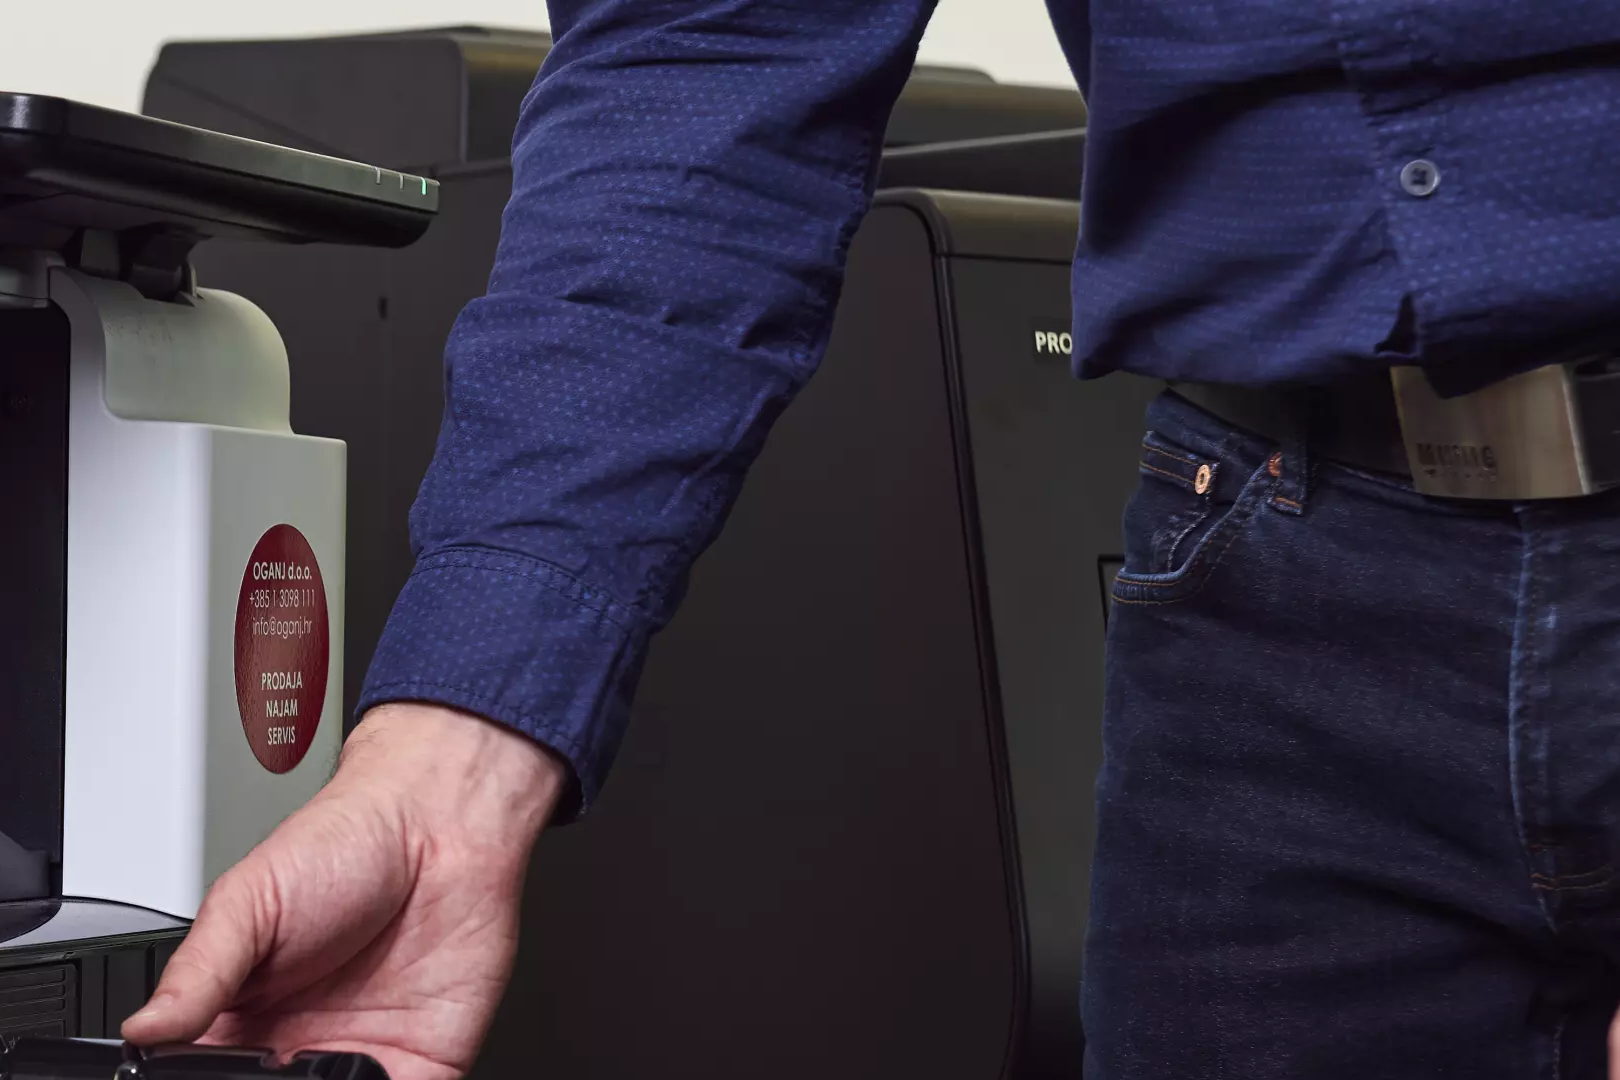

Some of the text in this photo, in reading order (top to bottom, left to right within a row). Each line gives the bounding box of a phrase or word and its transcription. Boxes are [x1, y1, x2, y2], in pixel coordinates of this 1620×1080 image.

[1034, 330, 1073, 355] PRO
[253, 561, 313, 580] OGANJ d.o.o.
[249, 589, 270, 608] +385
[279, 588, 299, 608] 3098
[302, 588, 315, 607] 111
[252, 616, 313, 640] info@oganj.hr
[261, 671, 303, 690] PRODAJA
[266, 699, 298, 717] NAJAM
[267, 726, 296, 745] SERVIS
